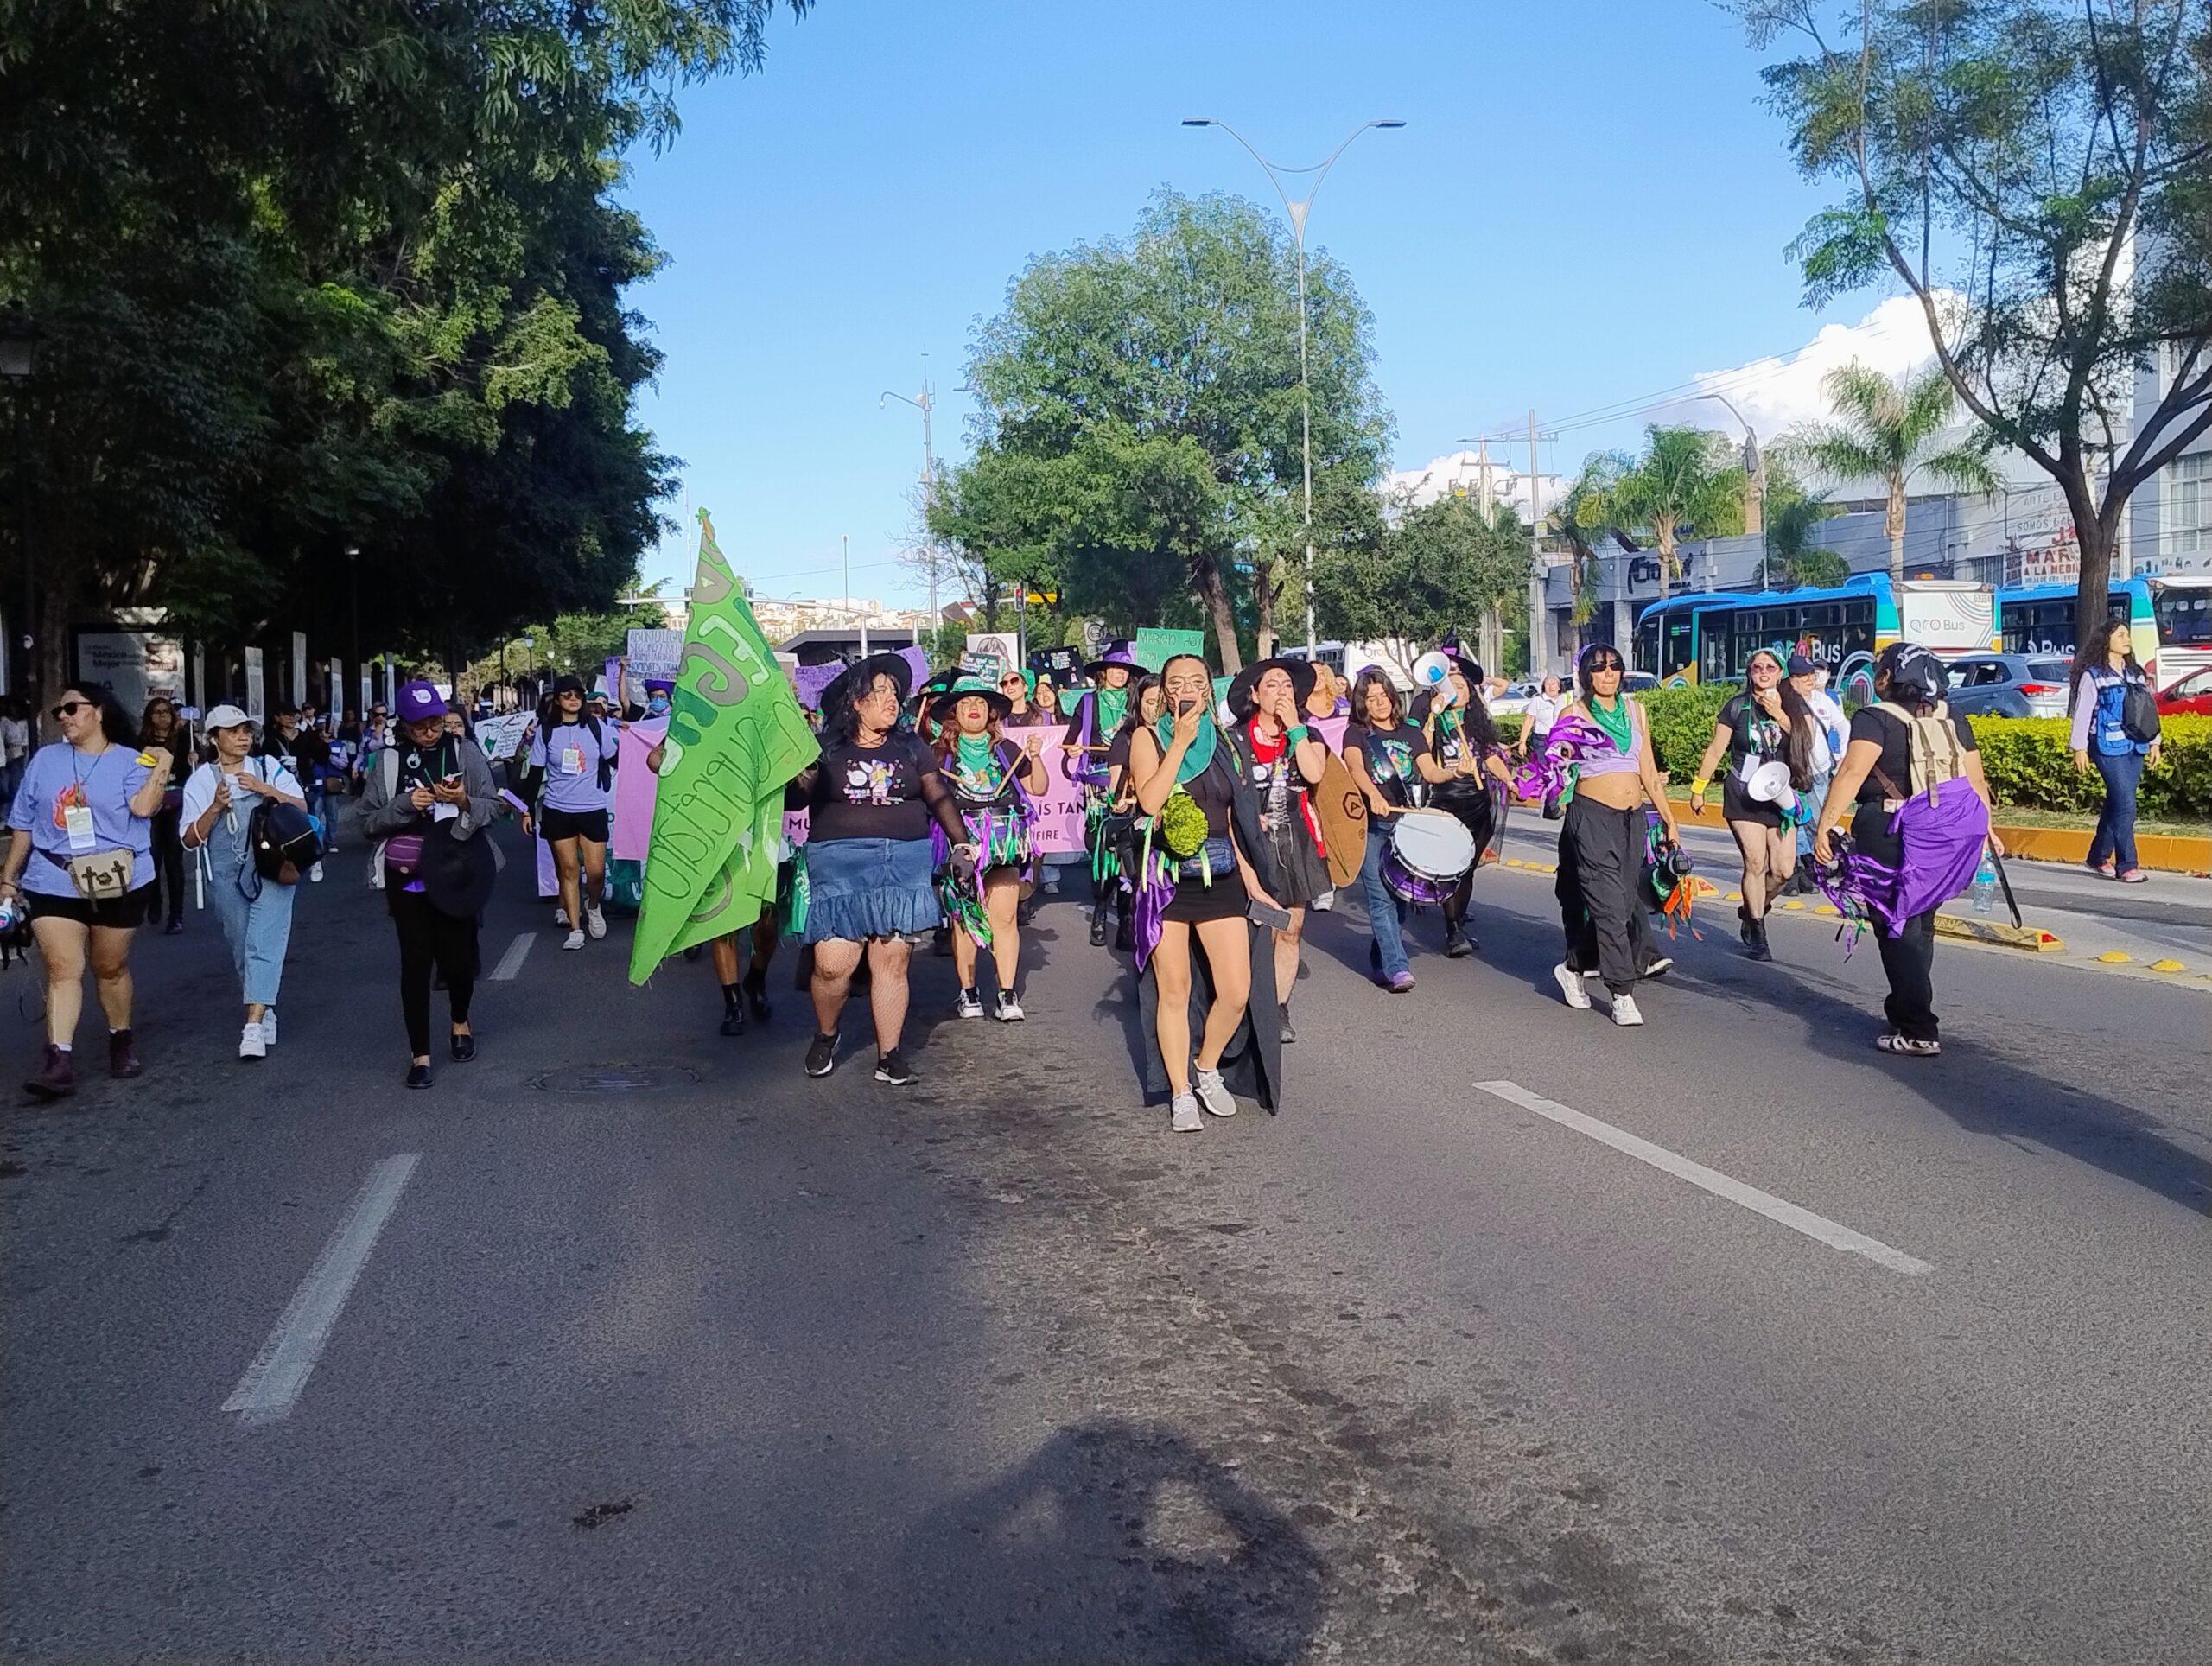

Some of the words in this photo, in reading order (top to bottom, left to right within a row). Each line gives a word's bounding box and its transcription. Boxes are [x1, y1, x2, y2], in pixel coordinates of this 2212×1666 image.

[2017, 518, 2049, 532] SOMOS
[2034, 565, 2047, 576] LA
[2050, 563, 2079, 575] MEDI
[1812, 639, 1841, 664] Bus
[1039, 799, 1052, 817] ÍS
[1057, 802, 1087, 815] TAN
[789, 817, 810, 830] MU
[1035, 830, 1059, 842] FIRE
